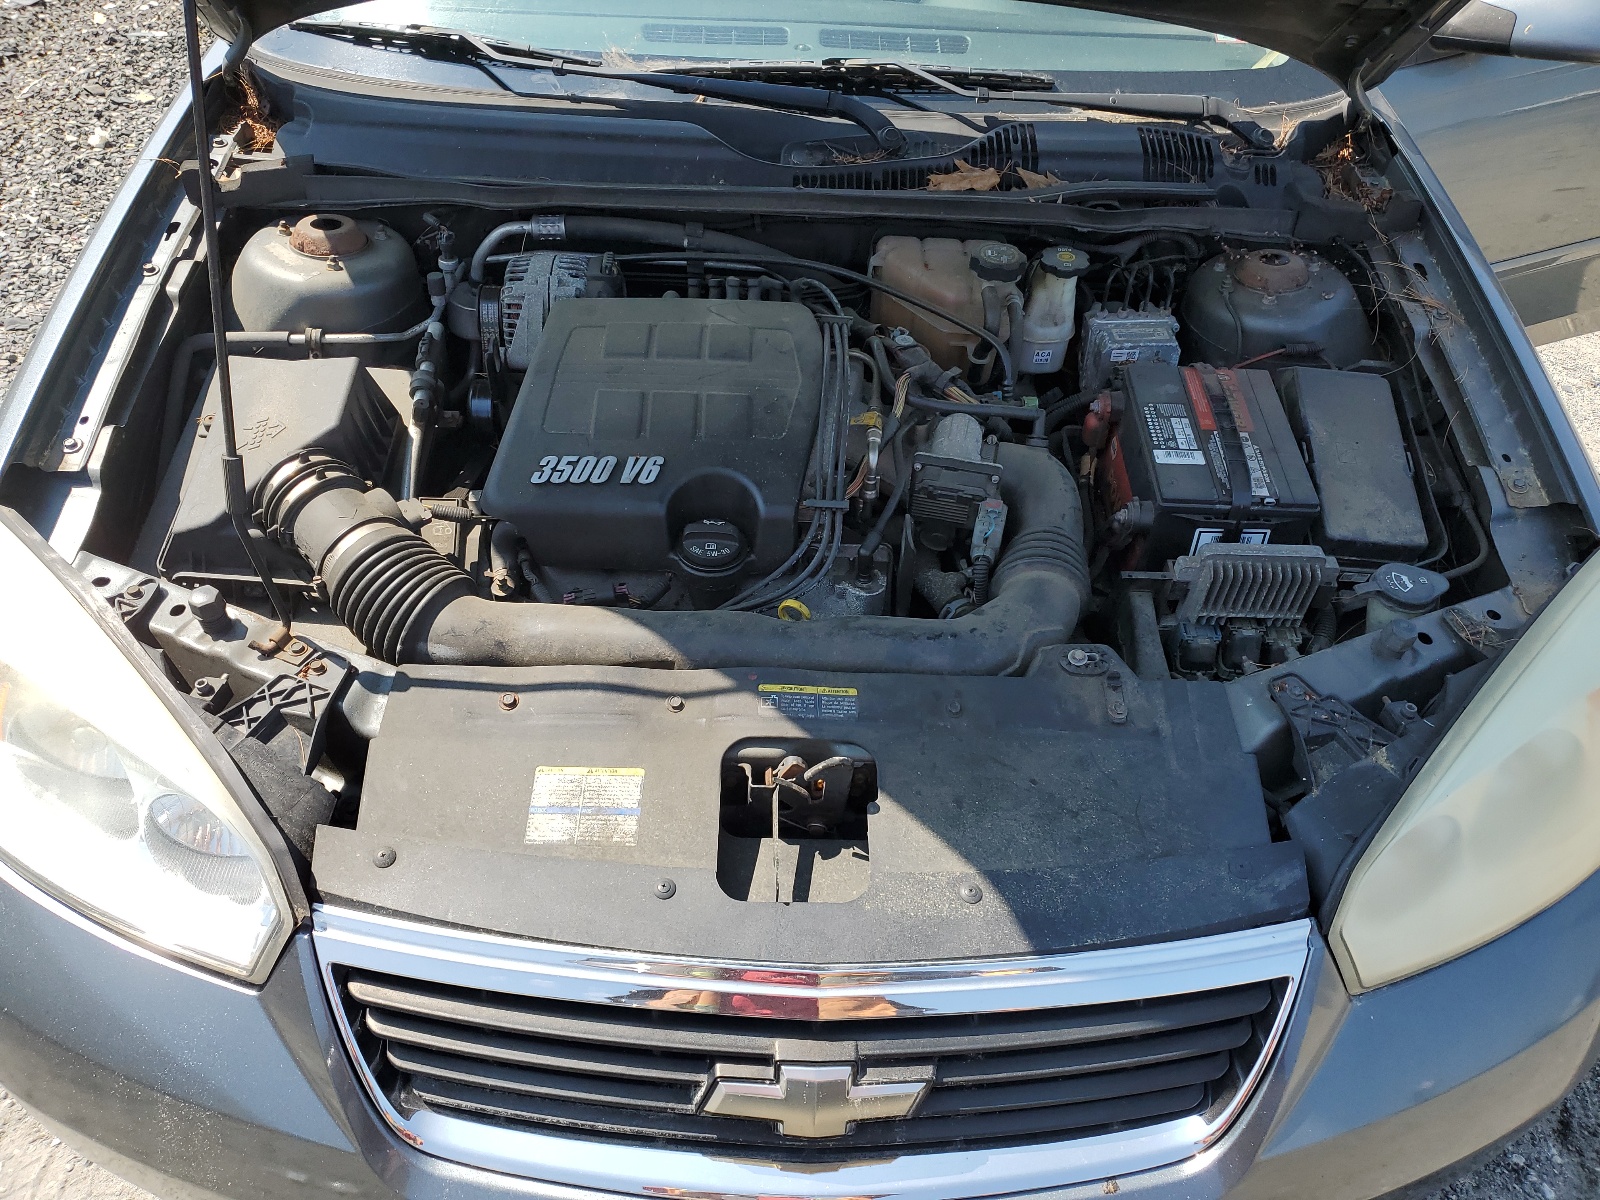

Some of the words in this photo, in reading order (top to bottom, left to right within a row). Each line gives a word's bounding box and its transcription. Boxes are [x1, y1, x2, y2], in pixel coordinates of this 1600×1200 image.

[530, 455, 617, 484] 3500
[620, 455, 665, 484] V6
[689, 545, 704, 556] SAE
[706, 547, 731, 558] 5W-30
